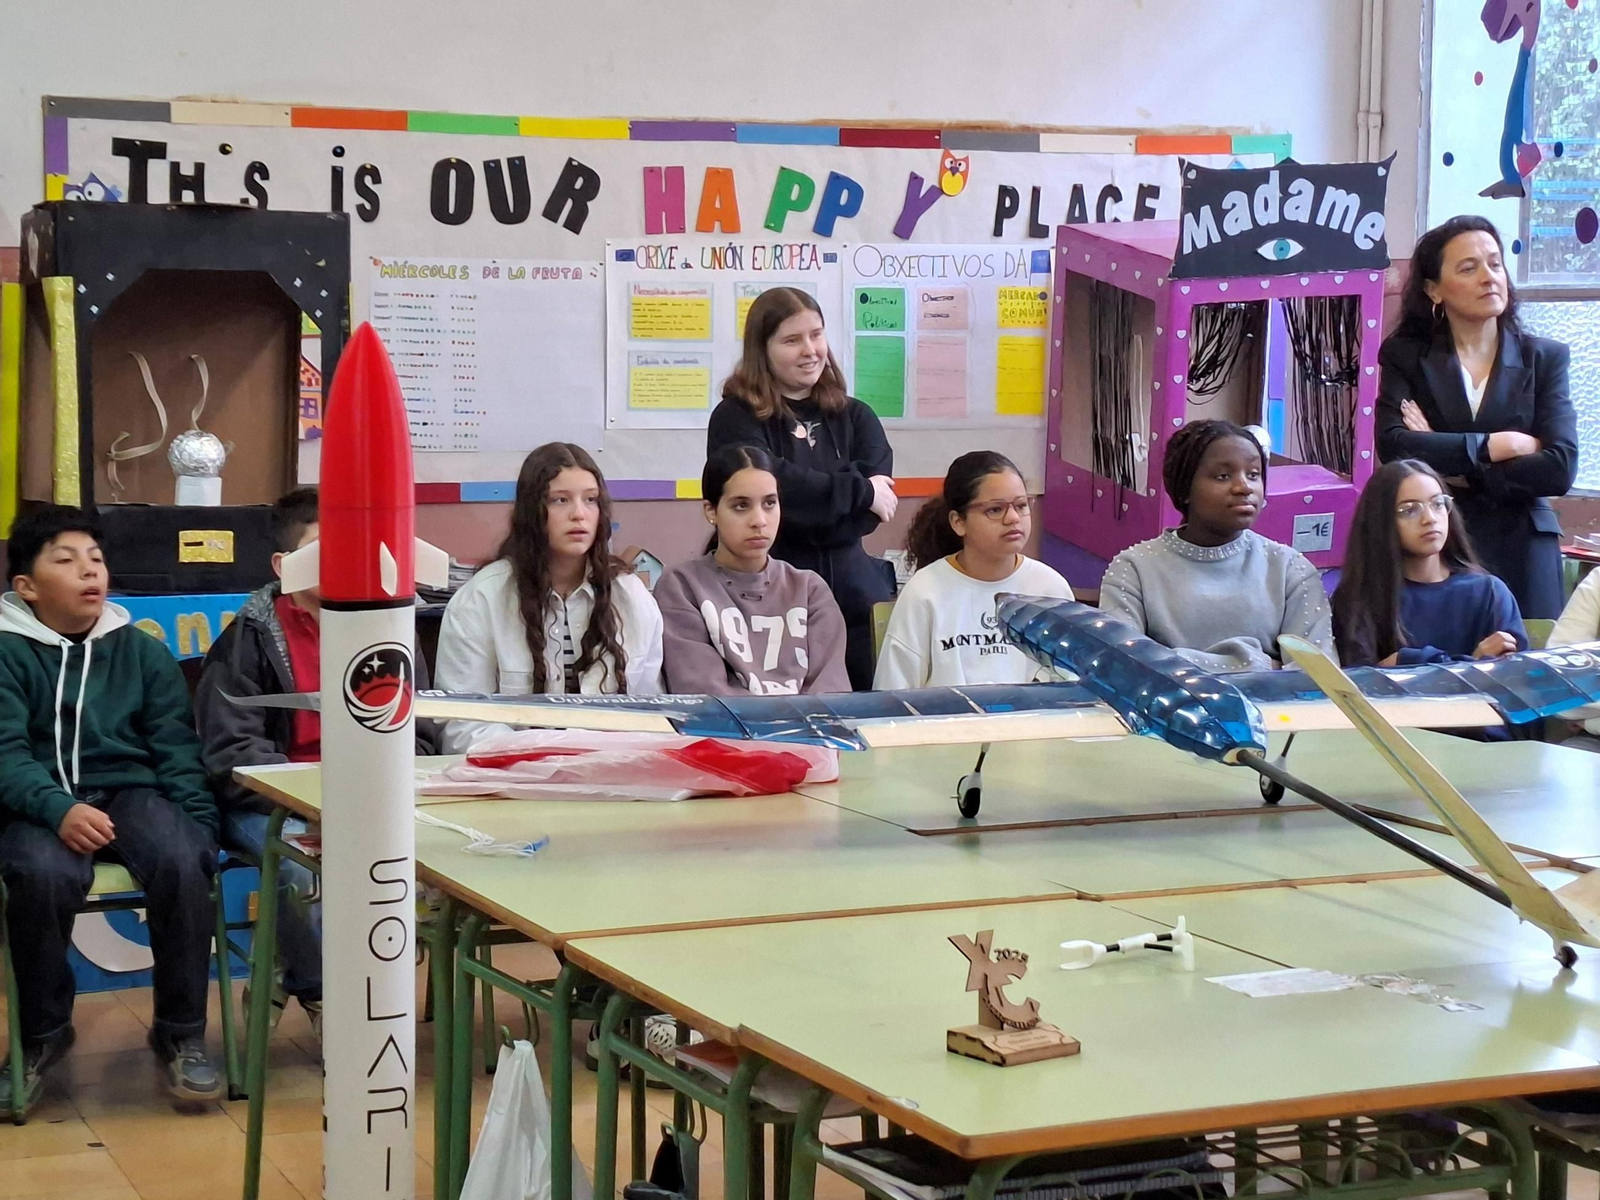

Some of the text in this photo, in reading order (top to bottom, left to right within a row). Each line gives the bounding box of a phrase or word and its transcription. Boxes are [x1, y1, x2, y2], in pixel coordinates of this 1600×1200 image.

[430, 156, 601, 235] OUR
[643, 165, 946, 240] HAPPY
[1182, 170, 1386, 255] Madame
[380, 260, 583, 280] MIÉRCOLES DE LA FRUTA
[635, 245, 678, 271] ORIXE
[701, 242, 745, 271] UNIÓN
[752, 243, 821, 271] EUROPEA
[1004, 249, 1028, 278] DA
